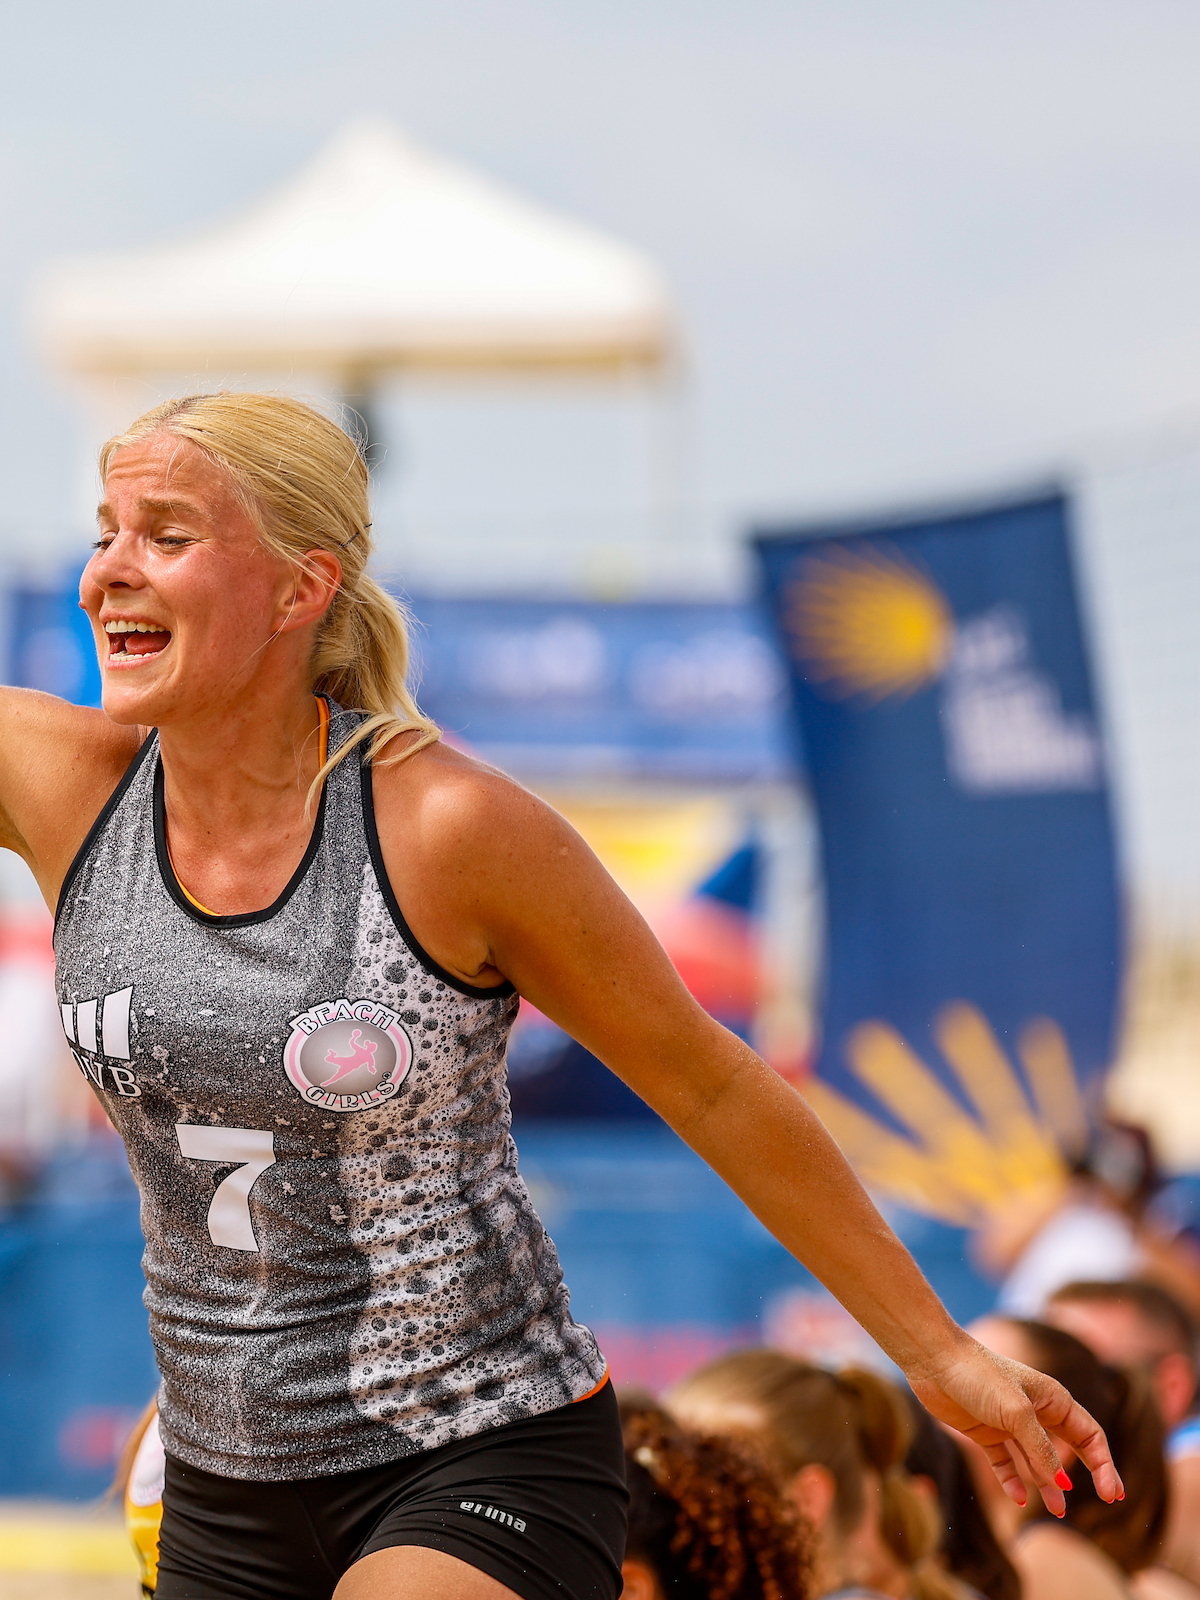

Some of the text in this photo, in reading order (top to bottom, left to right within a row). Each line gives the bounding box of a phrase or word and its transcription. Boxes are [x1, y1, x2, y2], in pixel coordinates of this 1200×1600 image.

[297, 1004, 394, 1036] BEACH
[175, 1124, 276, 1252] 7
[460, 1501, 527, 1533] erima
